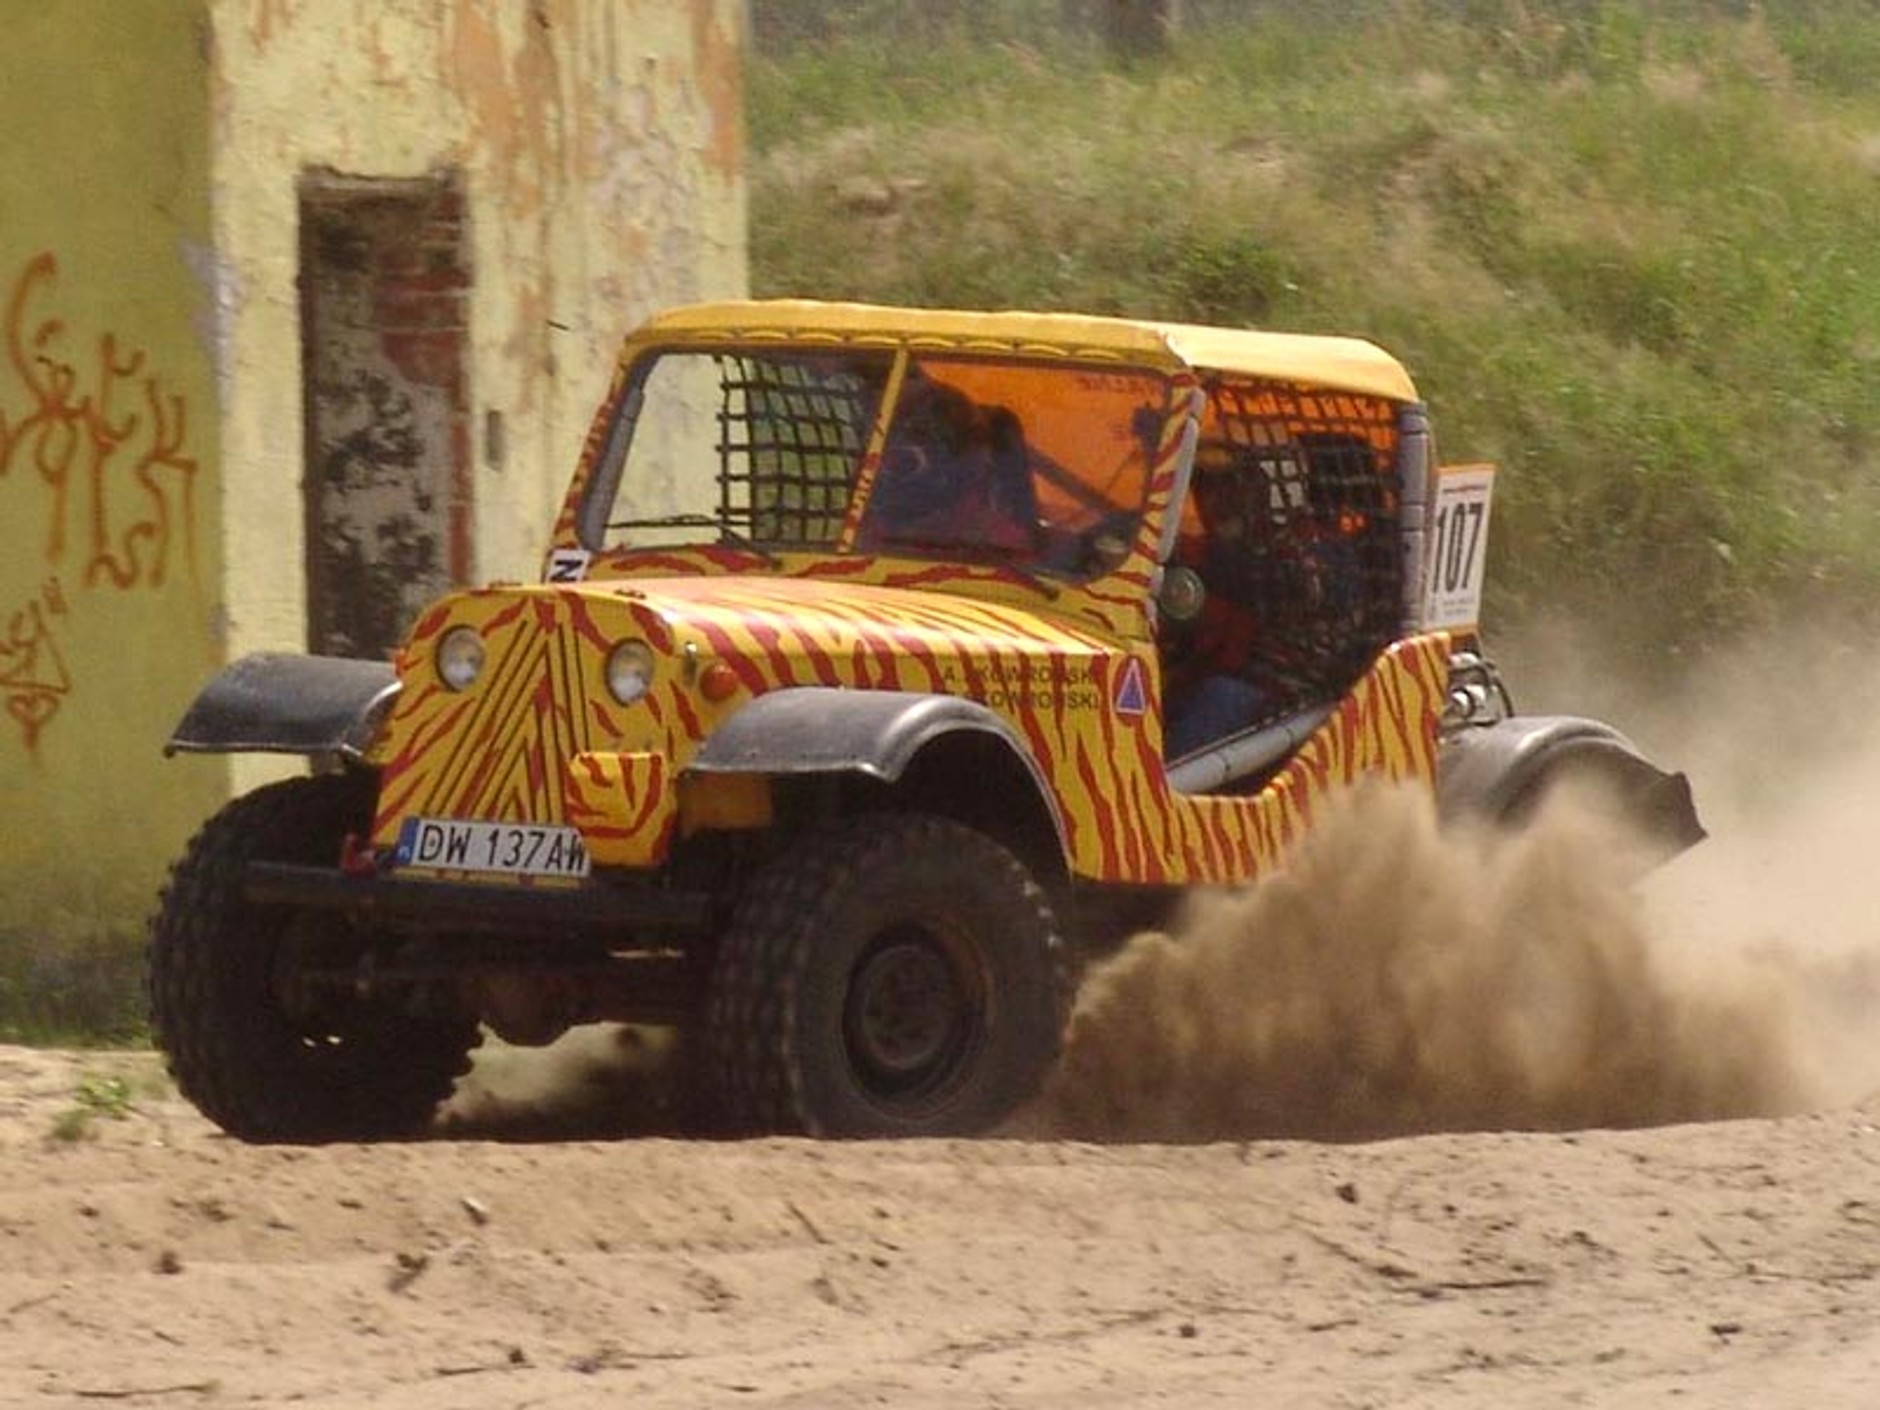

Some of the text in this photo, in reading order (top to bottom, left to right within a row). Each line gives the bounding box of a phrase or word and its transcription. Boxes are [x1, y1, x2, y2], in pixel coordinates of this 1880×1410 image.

[1432, 502, 1483, 593] 107
[418, 824, 586, 873] DW 137AW
